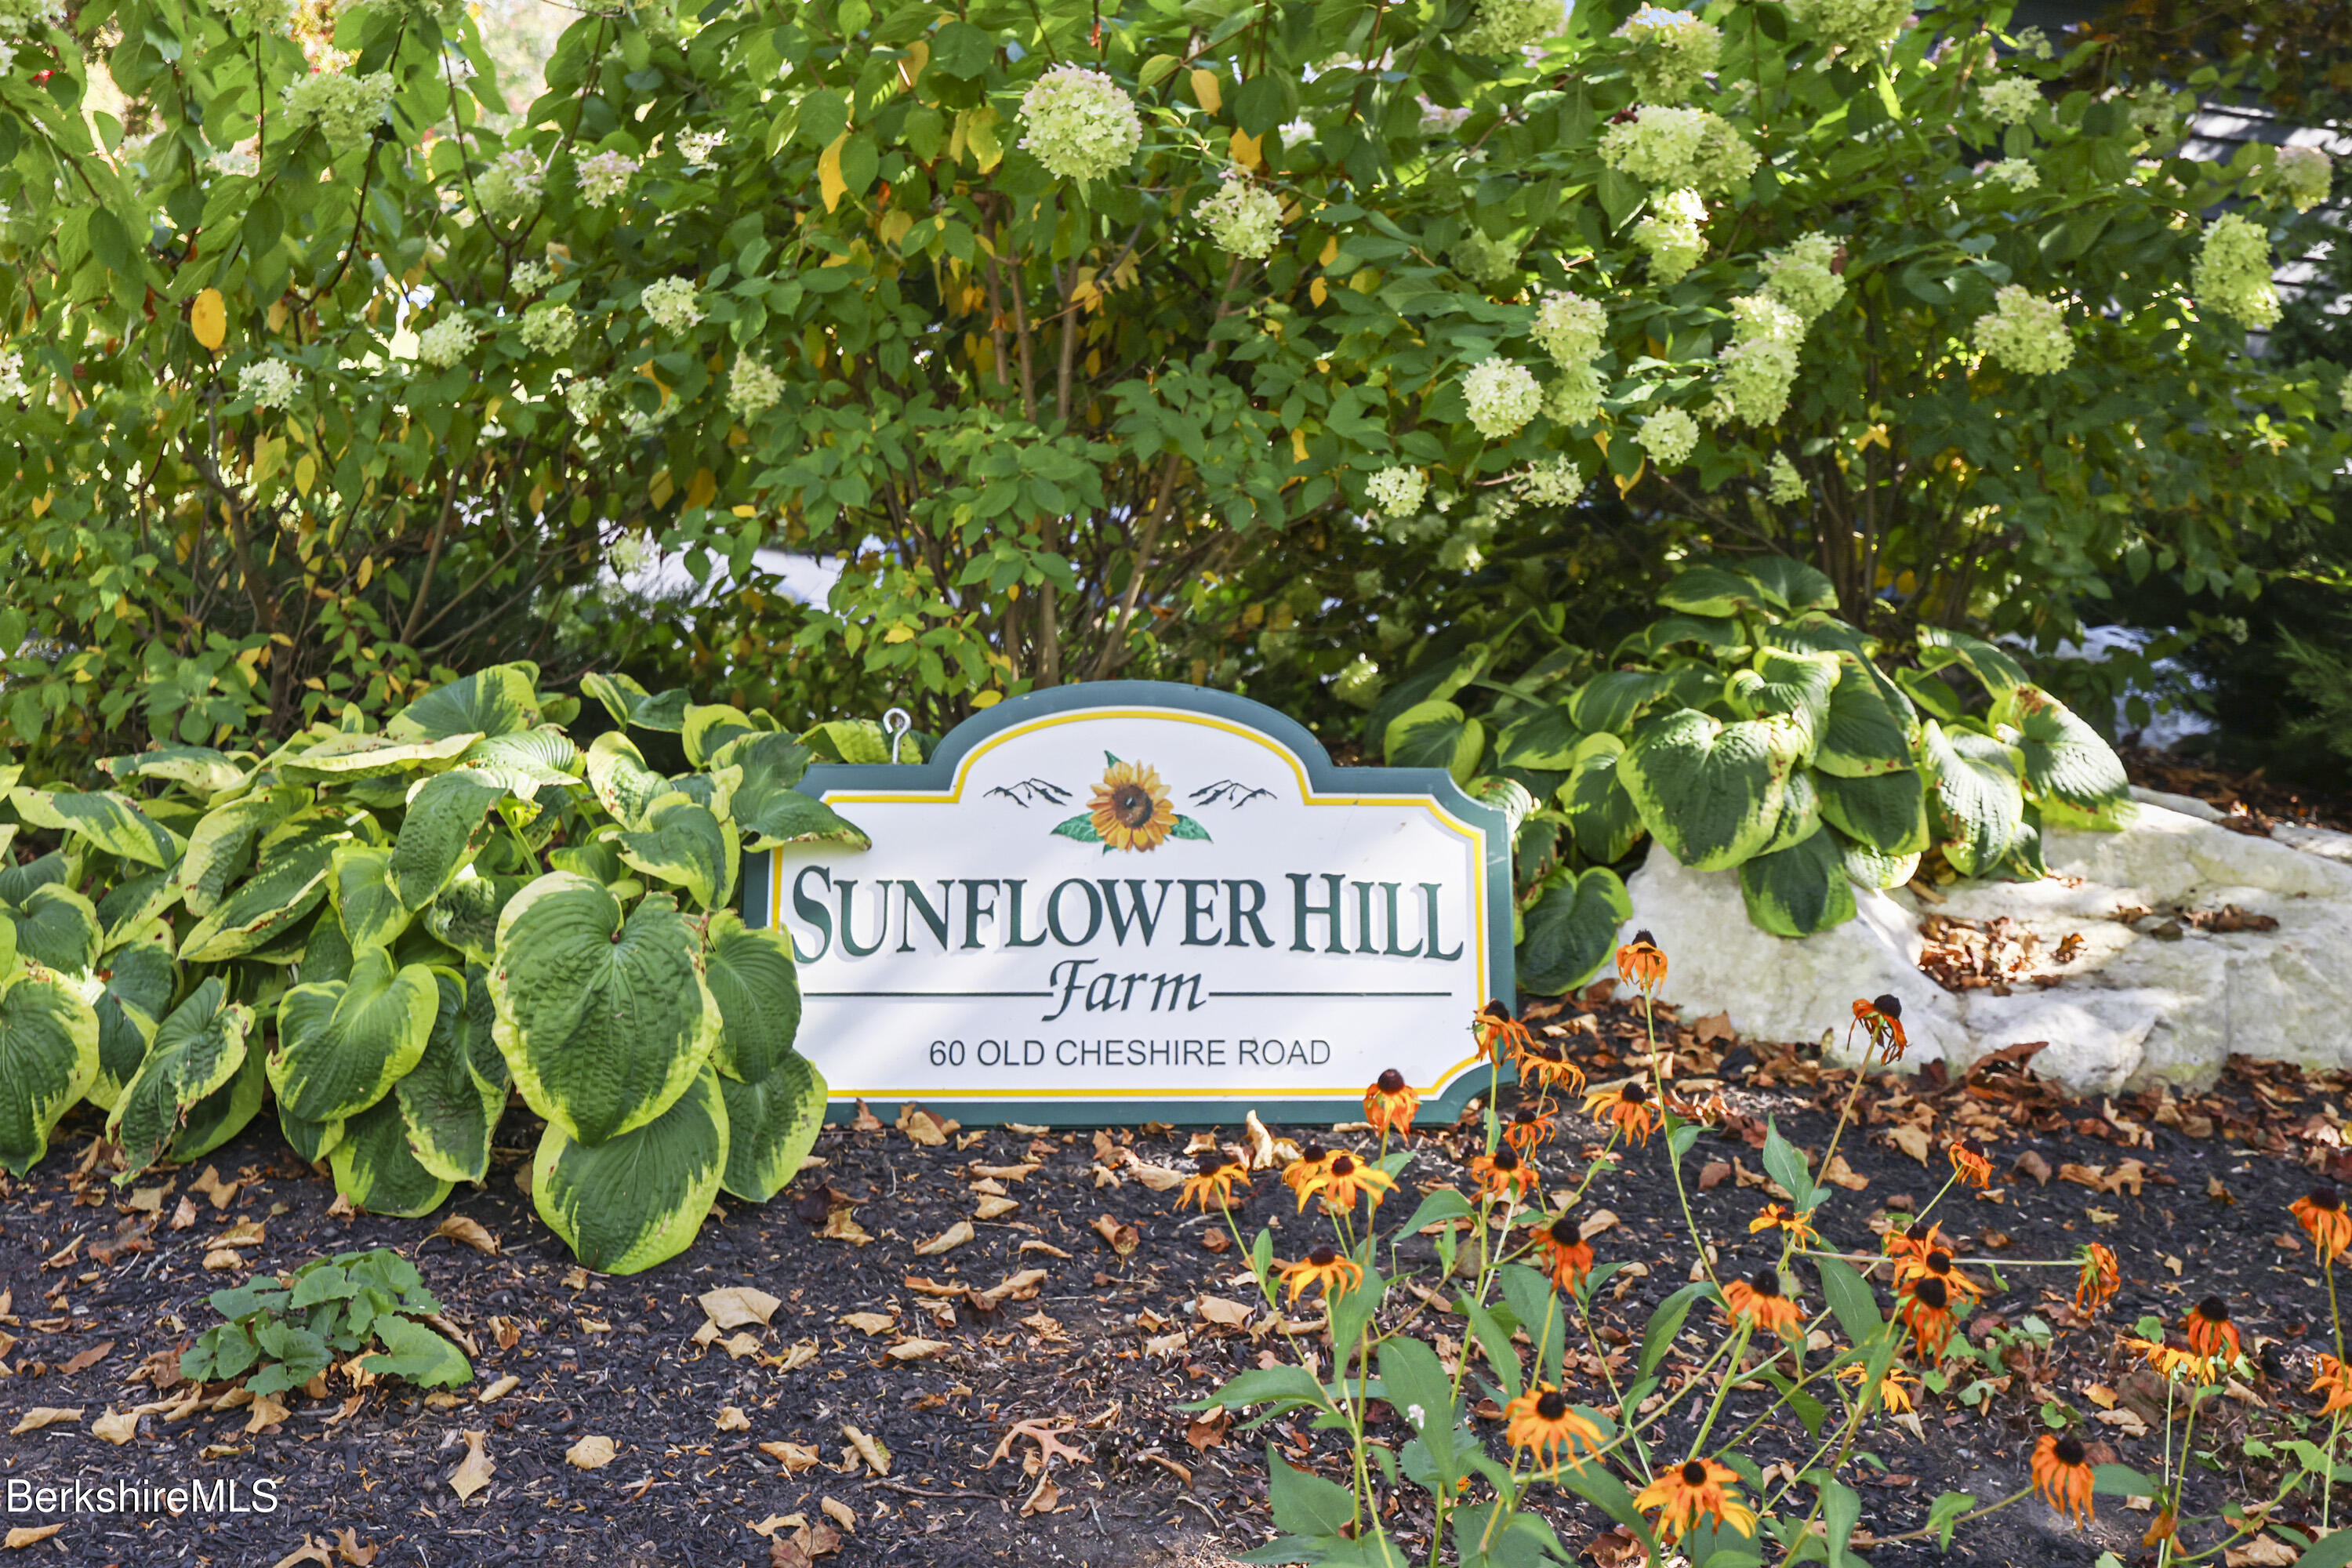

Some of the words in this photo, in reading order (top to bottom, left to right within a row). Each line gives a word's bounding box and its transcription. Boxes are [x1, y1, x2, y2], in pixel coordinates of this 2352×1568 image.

[792, 865, 1275, 964] SUNFLOWER
[1285, 873, 1464, 960] HILL
[1041, 958, 1207, 1022] Farm
[930, 1040, 966, 1066] 60
[977, 1040, 1045, 1066] OLD
[1054, 1040, 1226, 1067] CHESHIRE
[1239, 1040, 1331, 1066] ROAD
